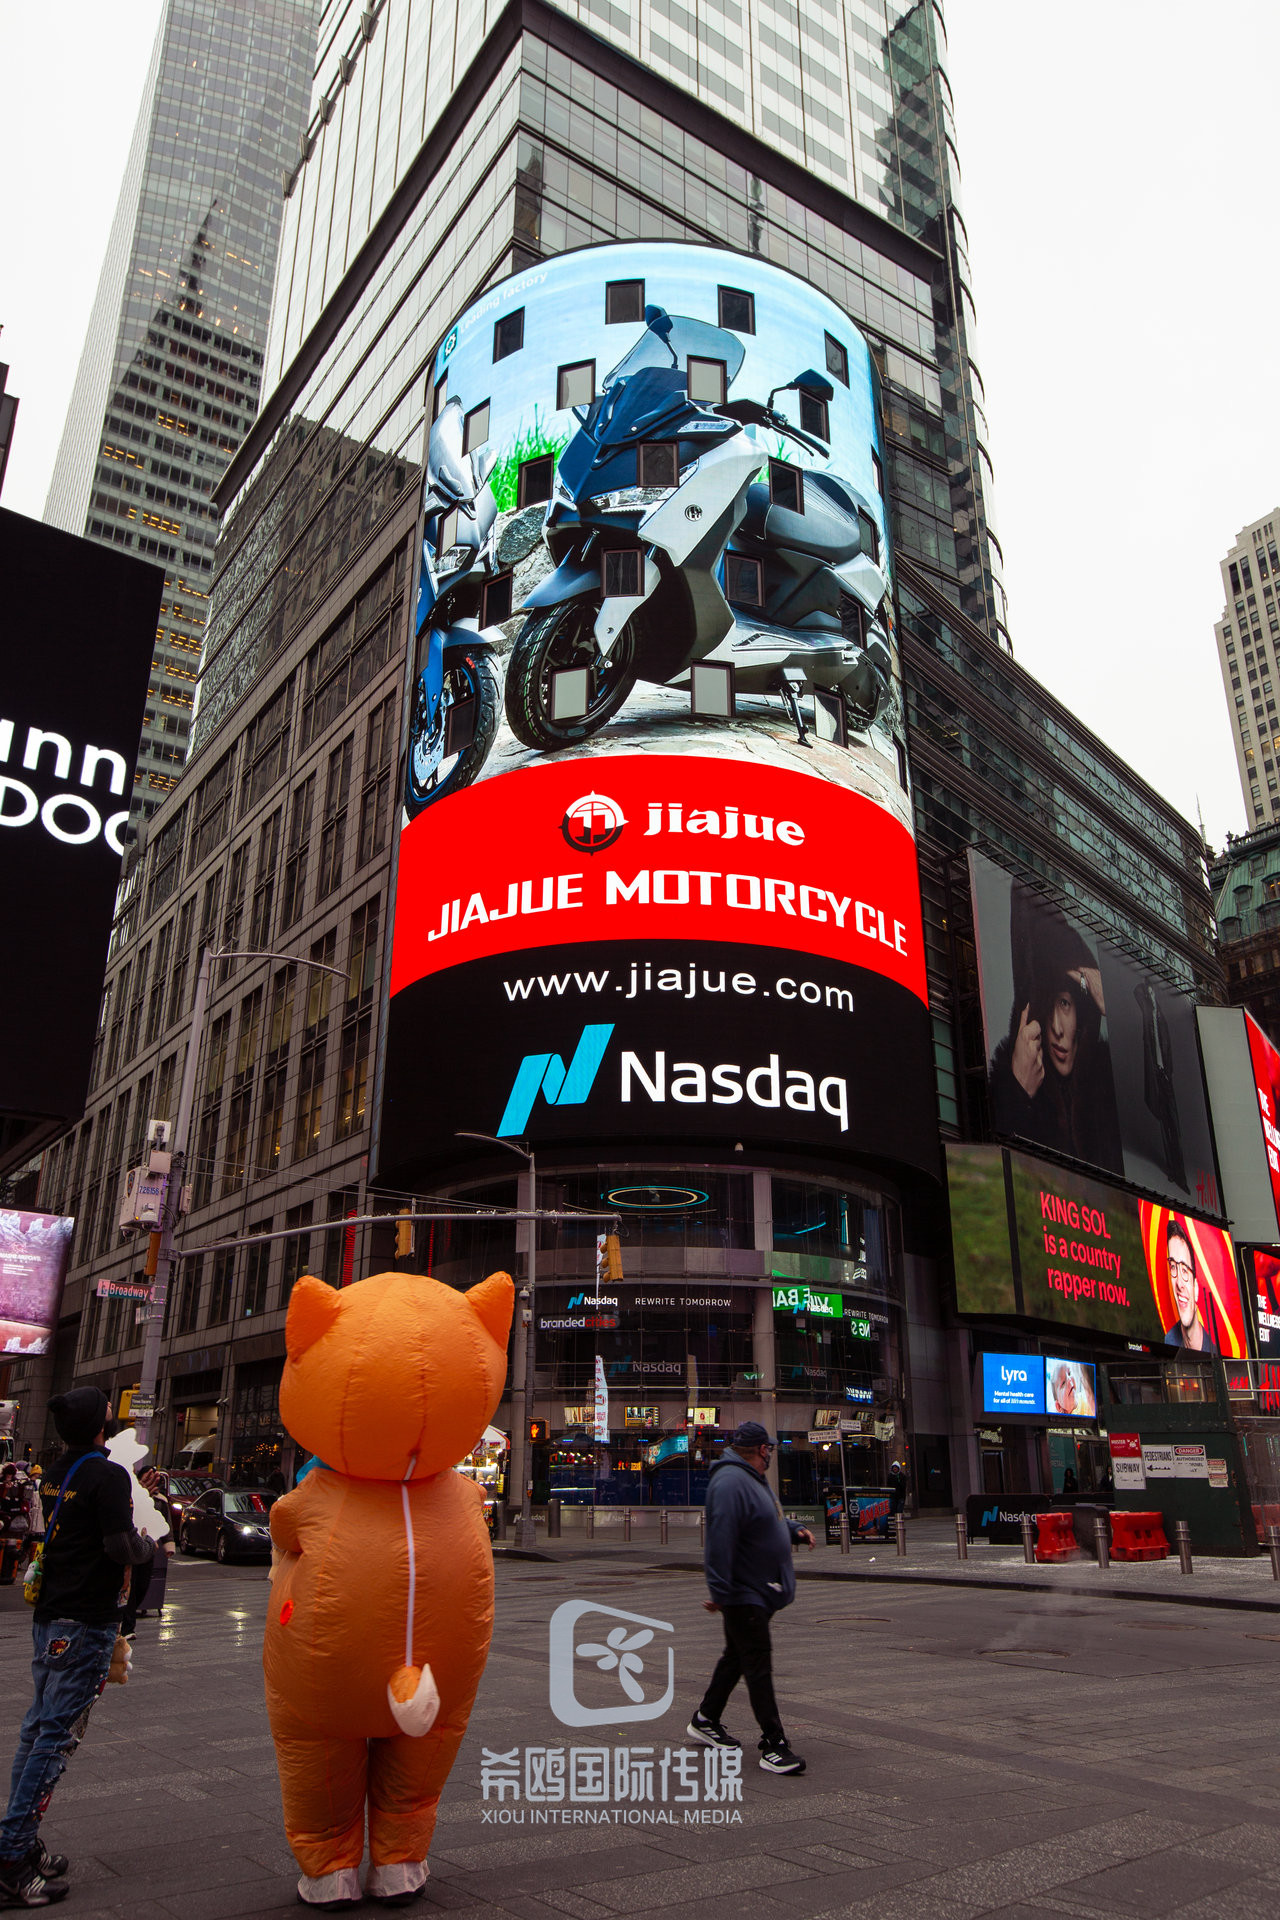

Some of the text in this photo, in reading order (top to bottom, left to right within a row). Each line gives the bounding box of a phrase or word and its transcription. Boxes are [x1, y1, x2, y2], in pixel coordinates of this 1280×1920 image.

[643, 802, 805, 846] jiajue
[427, 869, 908, 957] JIAJUE MOTORCYCLE
[503, 962, 855, 1012] www.jiajue.com
[620, 1050, 849, 1133] Nasdaq
[1040, 1191, 1111, 1239] KING SOL
[1043, 1225, 1121, 1279] is a country
[109, 1283, 149, 1299] Broadway
[584, 1296, 732, 1307] Nasdaq REWRITE TOMORROW
[1047, 1268, 1130, 1307] rapper now.
[844, 1308, 867, 1319] REWRITE
[632, 1361, 682, 1375] Nasdaq
[1115, 1462, 1140, 1473] SUBWAY
[1144, 1451, 1172, 1462] PEDESTRIANS
[858, 1499, 891, 1528] AMAZE
